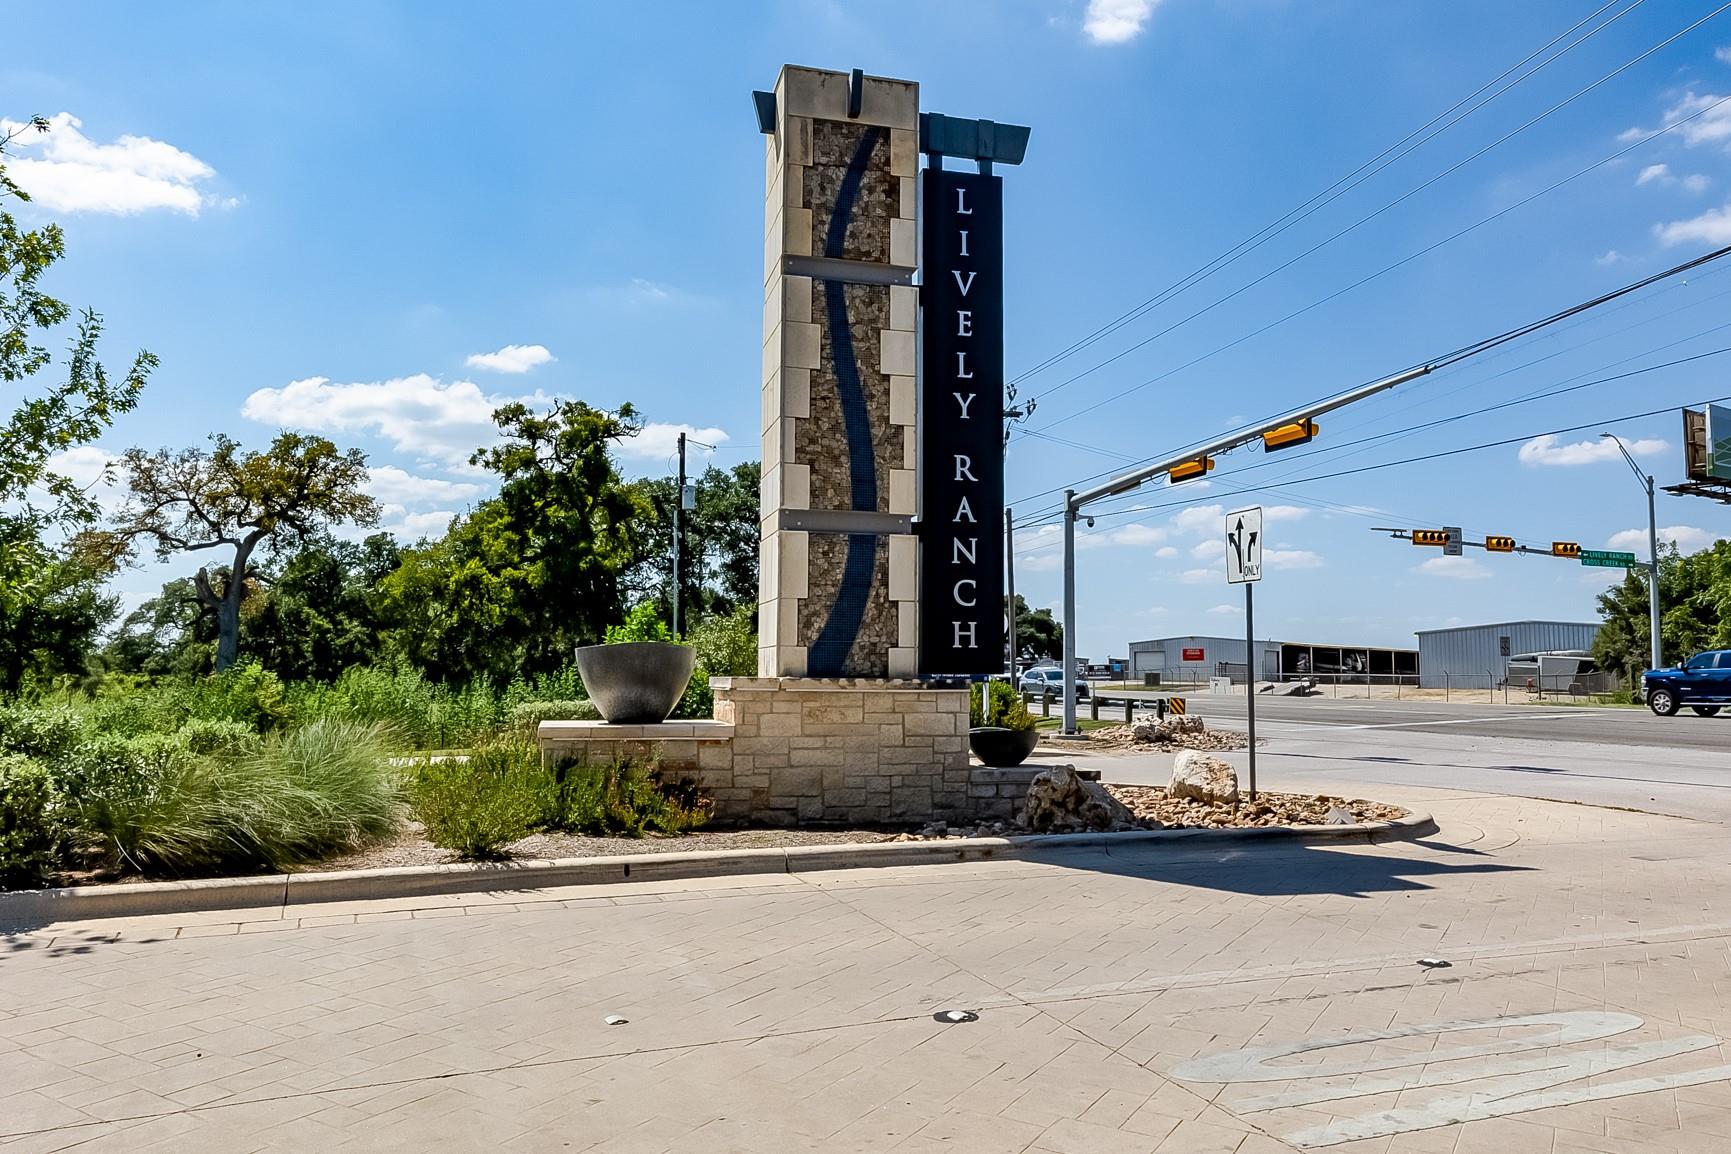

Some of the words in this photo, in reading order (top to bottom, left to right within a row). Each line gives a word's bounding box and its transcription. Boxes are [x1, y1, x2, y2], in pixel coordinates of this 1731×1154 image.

[951, 188, 977, 419] LIVELY
[951, 454, 979, 649] RANCH
[1244, 564, 1260, 577] ONLY
[1589, 551, 1607, 559] LIVELY
